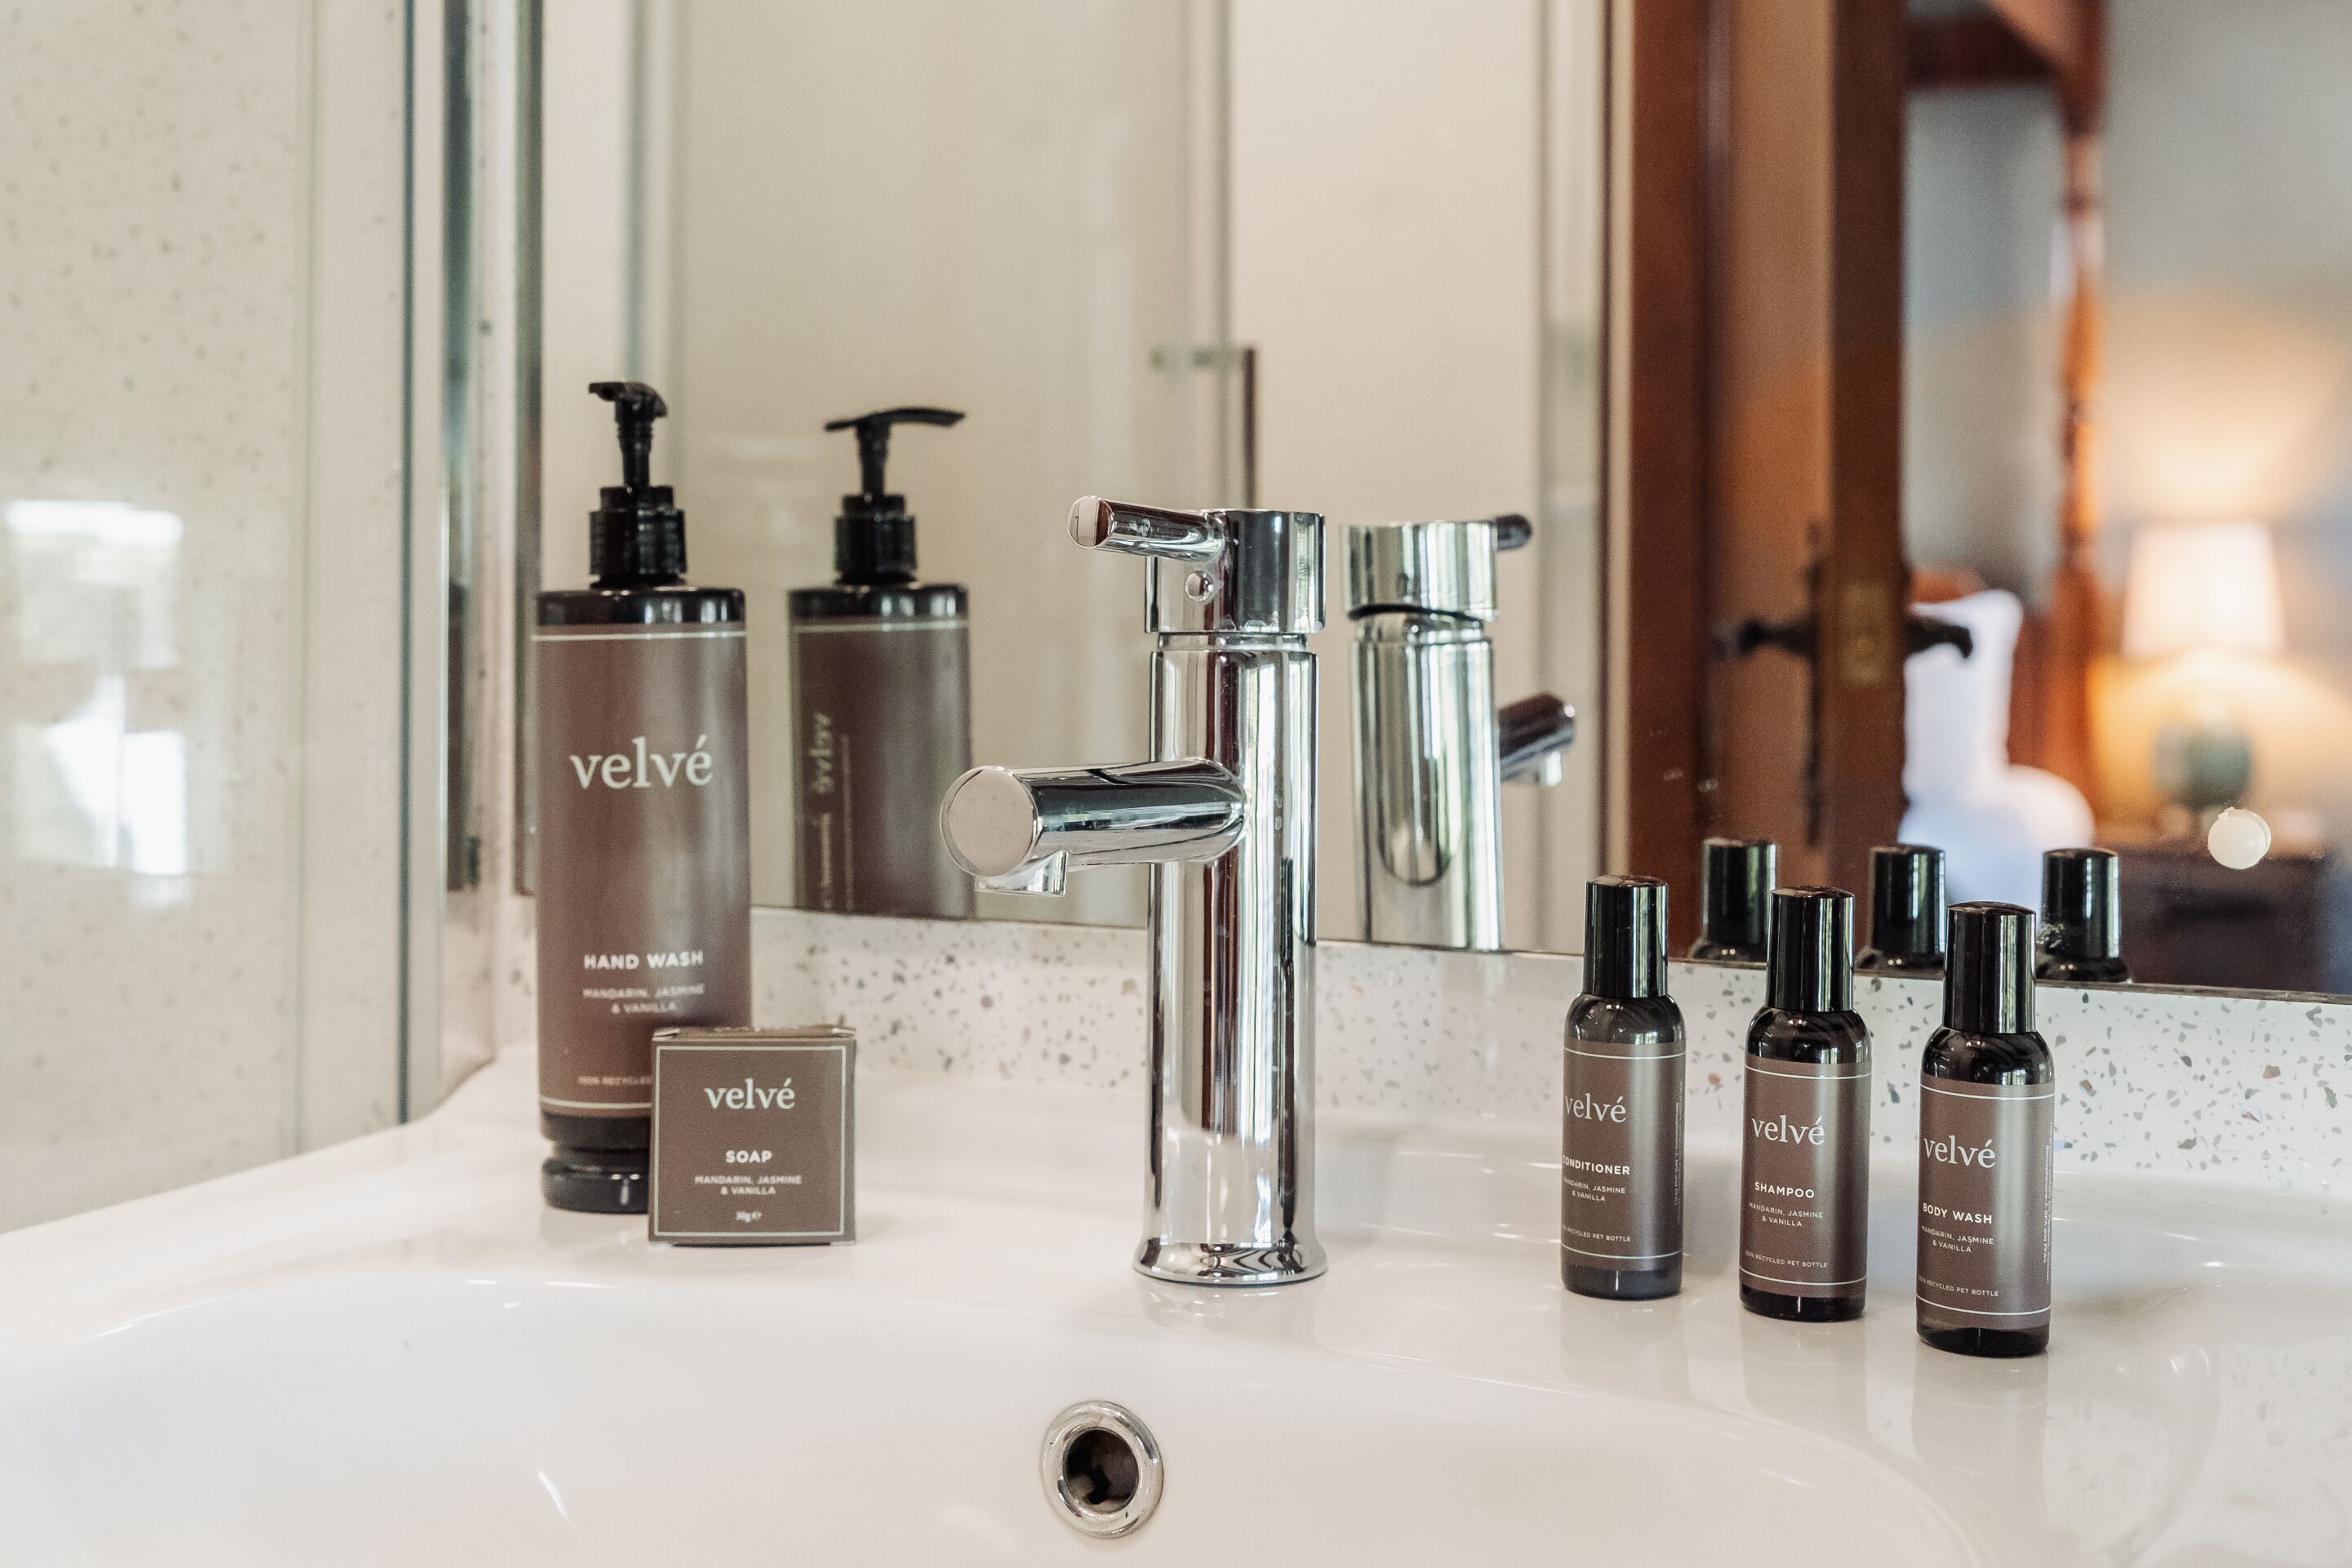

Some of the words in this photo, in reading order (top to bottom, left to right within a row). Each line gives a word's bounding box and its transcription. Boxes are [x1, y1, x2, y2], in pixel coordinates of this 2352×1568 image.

[570, 735, 714, 788] velvé
[584, 953, 640, 970] HAND
[647, 950, 704, 969] WASH
[705, 1077, 795, 1109] velvé
[1565, 1093, 1626, 1123] velvé
[1752, 1115, 1825, 1145] velvé
[726, 1150, 772, 1163] SOAP
[1923, 1135, 1996, 1168] velvé
[1563, 1155, 1630, 1175] CONDITIONER
[1577, 1192, 1606, 1202] VANILLA
[1593, 1185, 1626, 1194] JASMINE
[1754, 1181, 1815, 1199] SHAMPOO
[1768, 1216, 1803, 1227] VANILLA
[1787, 1210, 1824, 1219] JASMINE
[1923, 1202, 1948, 1218] BODY
[1953, 1210, 1992, 1224] WASH
[1938, 1241, 1972, 1253] VANILLA
[1957, 1235, 1994, 1245] JASMINE
[1755, 1254, 1785, 1264] RECYCLED
[1927, 1279, 1954, 1291] RECYCLED
[1972, 1288, 1999, 1296] BOTTLE
